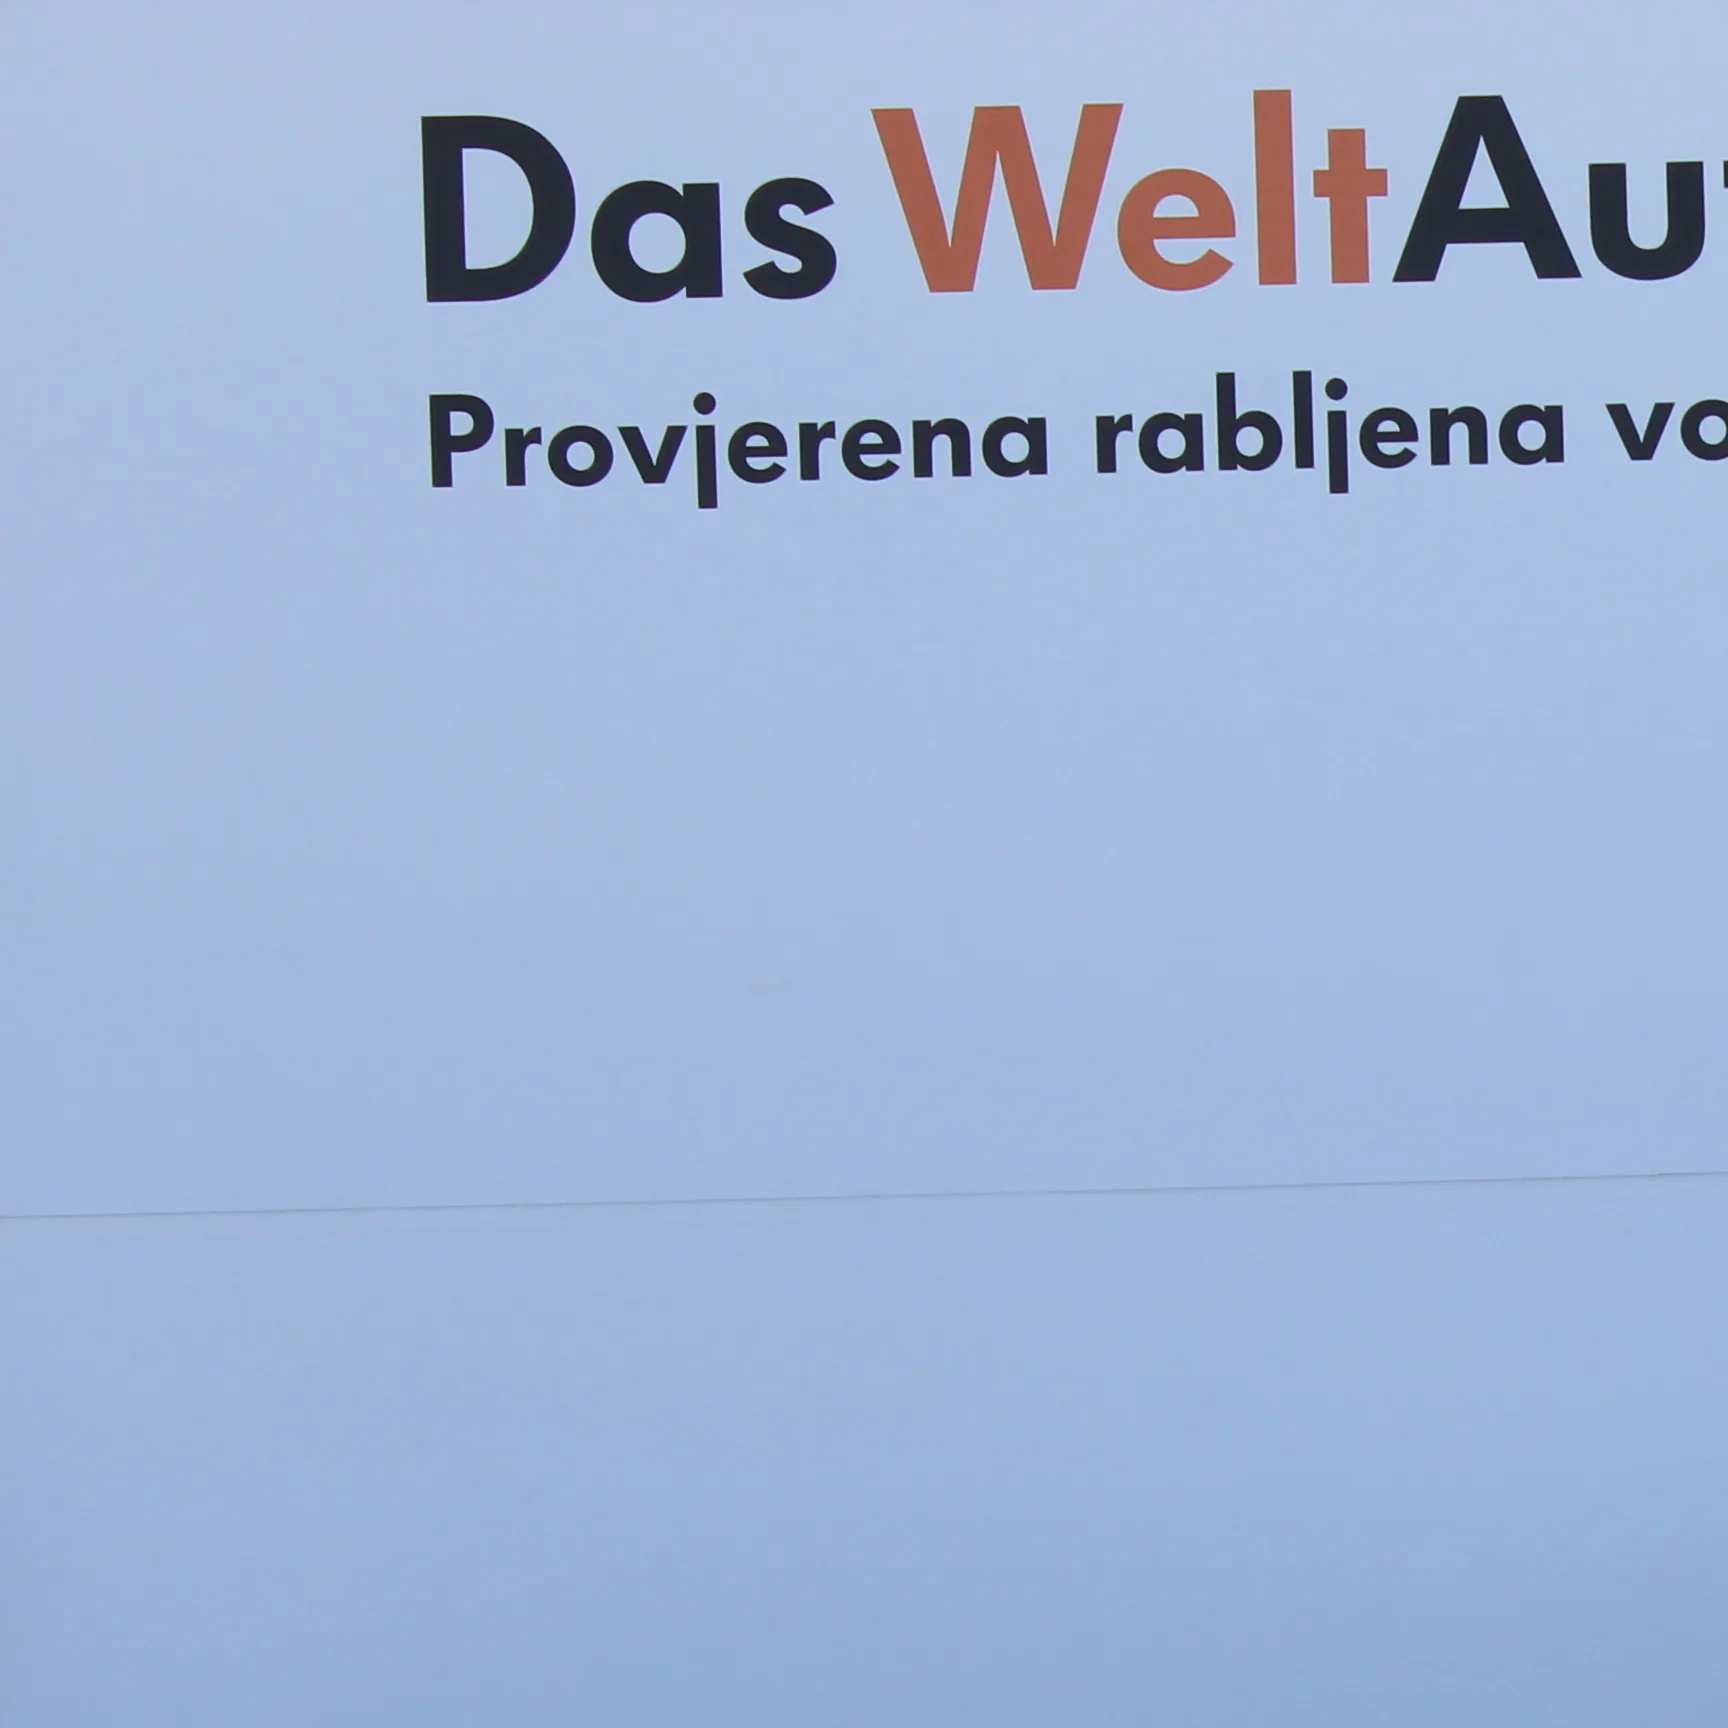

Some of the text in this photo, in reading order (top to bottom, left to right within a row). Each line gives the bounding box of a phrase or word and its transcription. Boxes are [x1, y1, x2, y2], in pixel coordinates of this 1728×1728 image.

[420, 115, 837, 303] Das
[428, 391, 1048, 510] Provjerena
[1095, 365, 1565, 494] rabljena
